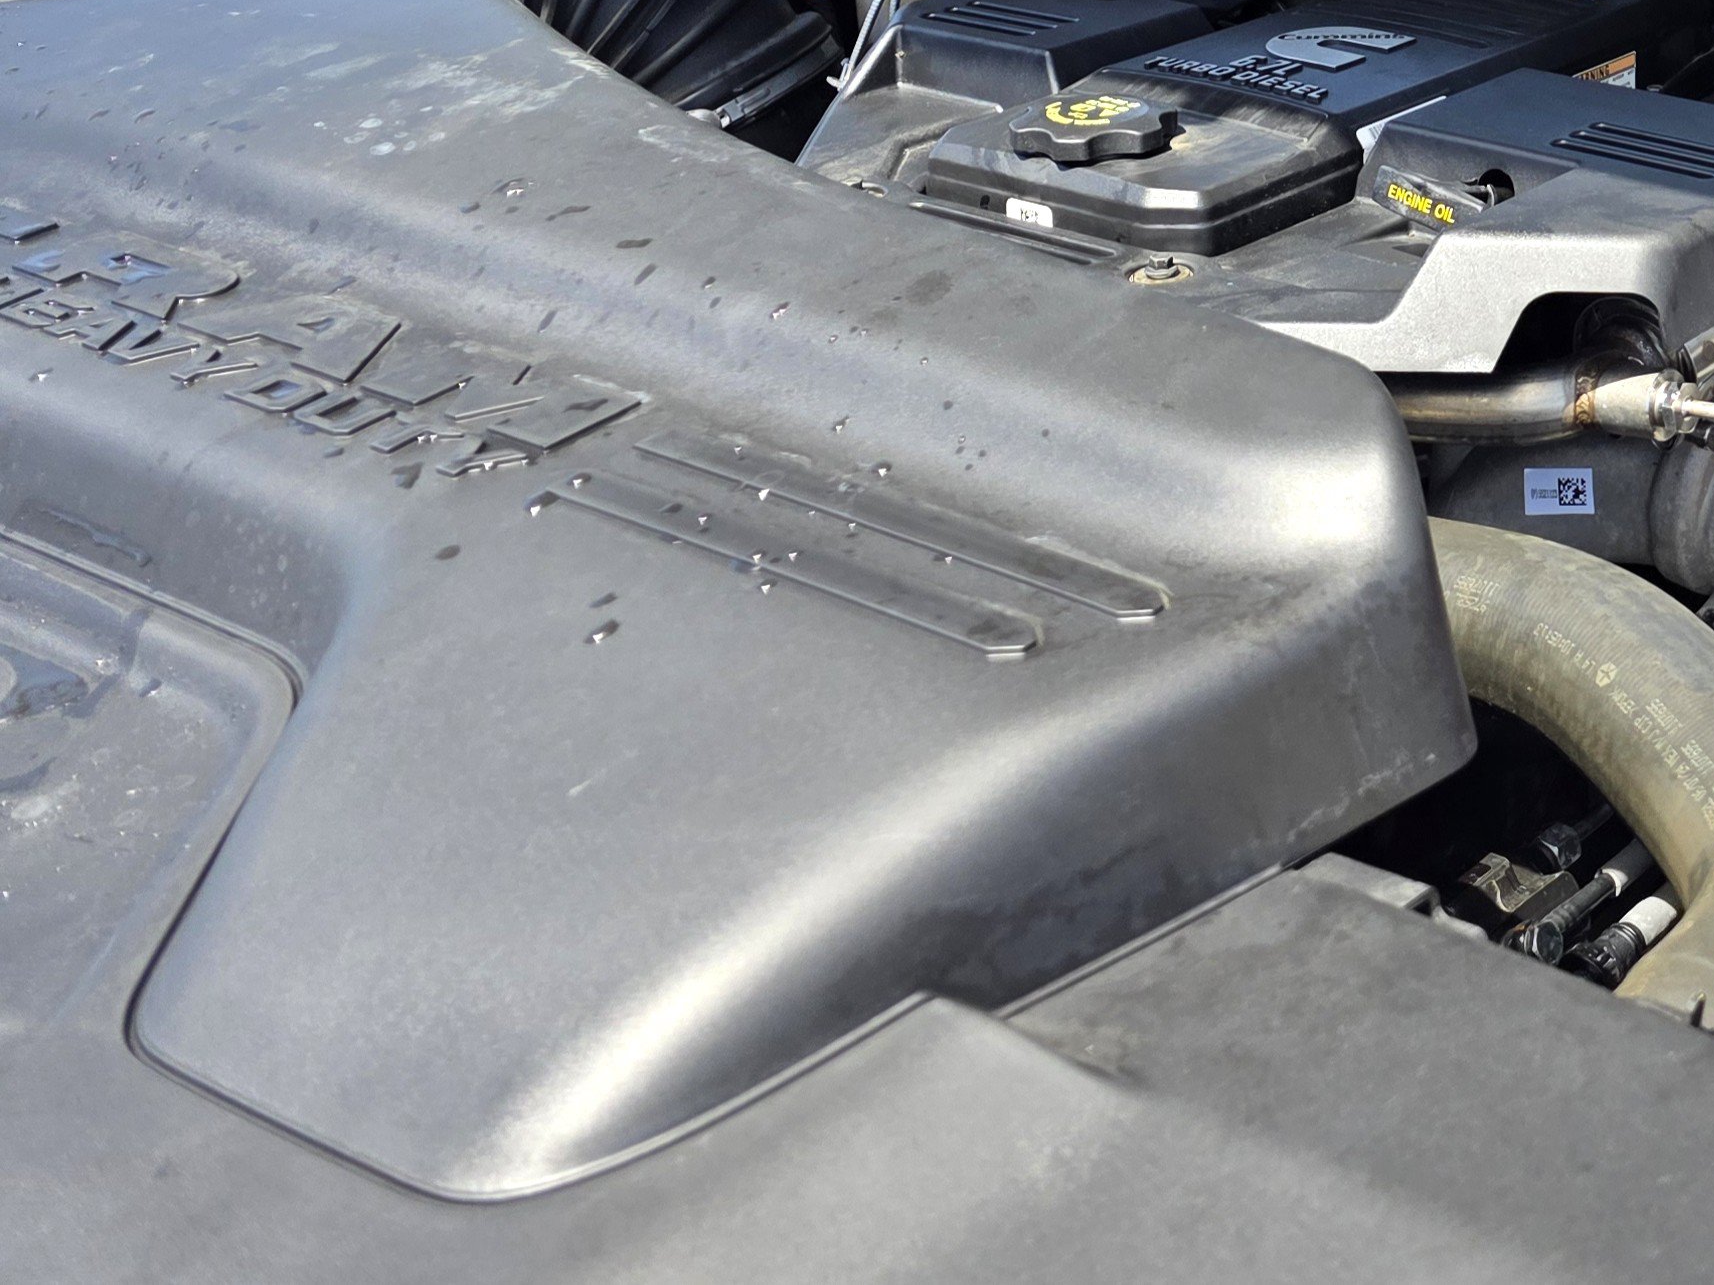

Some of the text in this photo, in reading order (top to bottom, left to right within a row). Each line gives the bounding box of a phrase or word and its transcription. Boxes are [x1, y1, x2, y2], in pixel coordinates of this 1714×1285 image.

[1144, 56, 1329, 104] TURBO DIESEL
[1387, 183, 1455, 224] ENGINE OIL
[223, 374, 530, 478] DUTY
